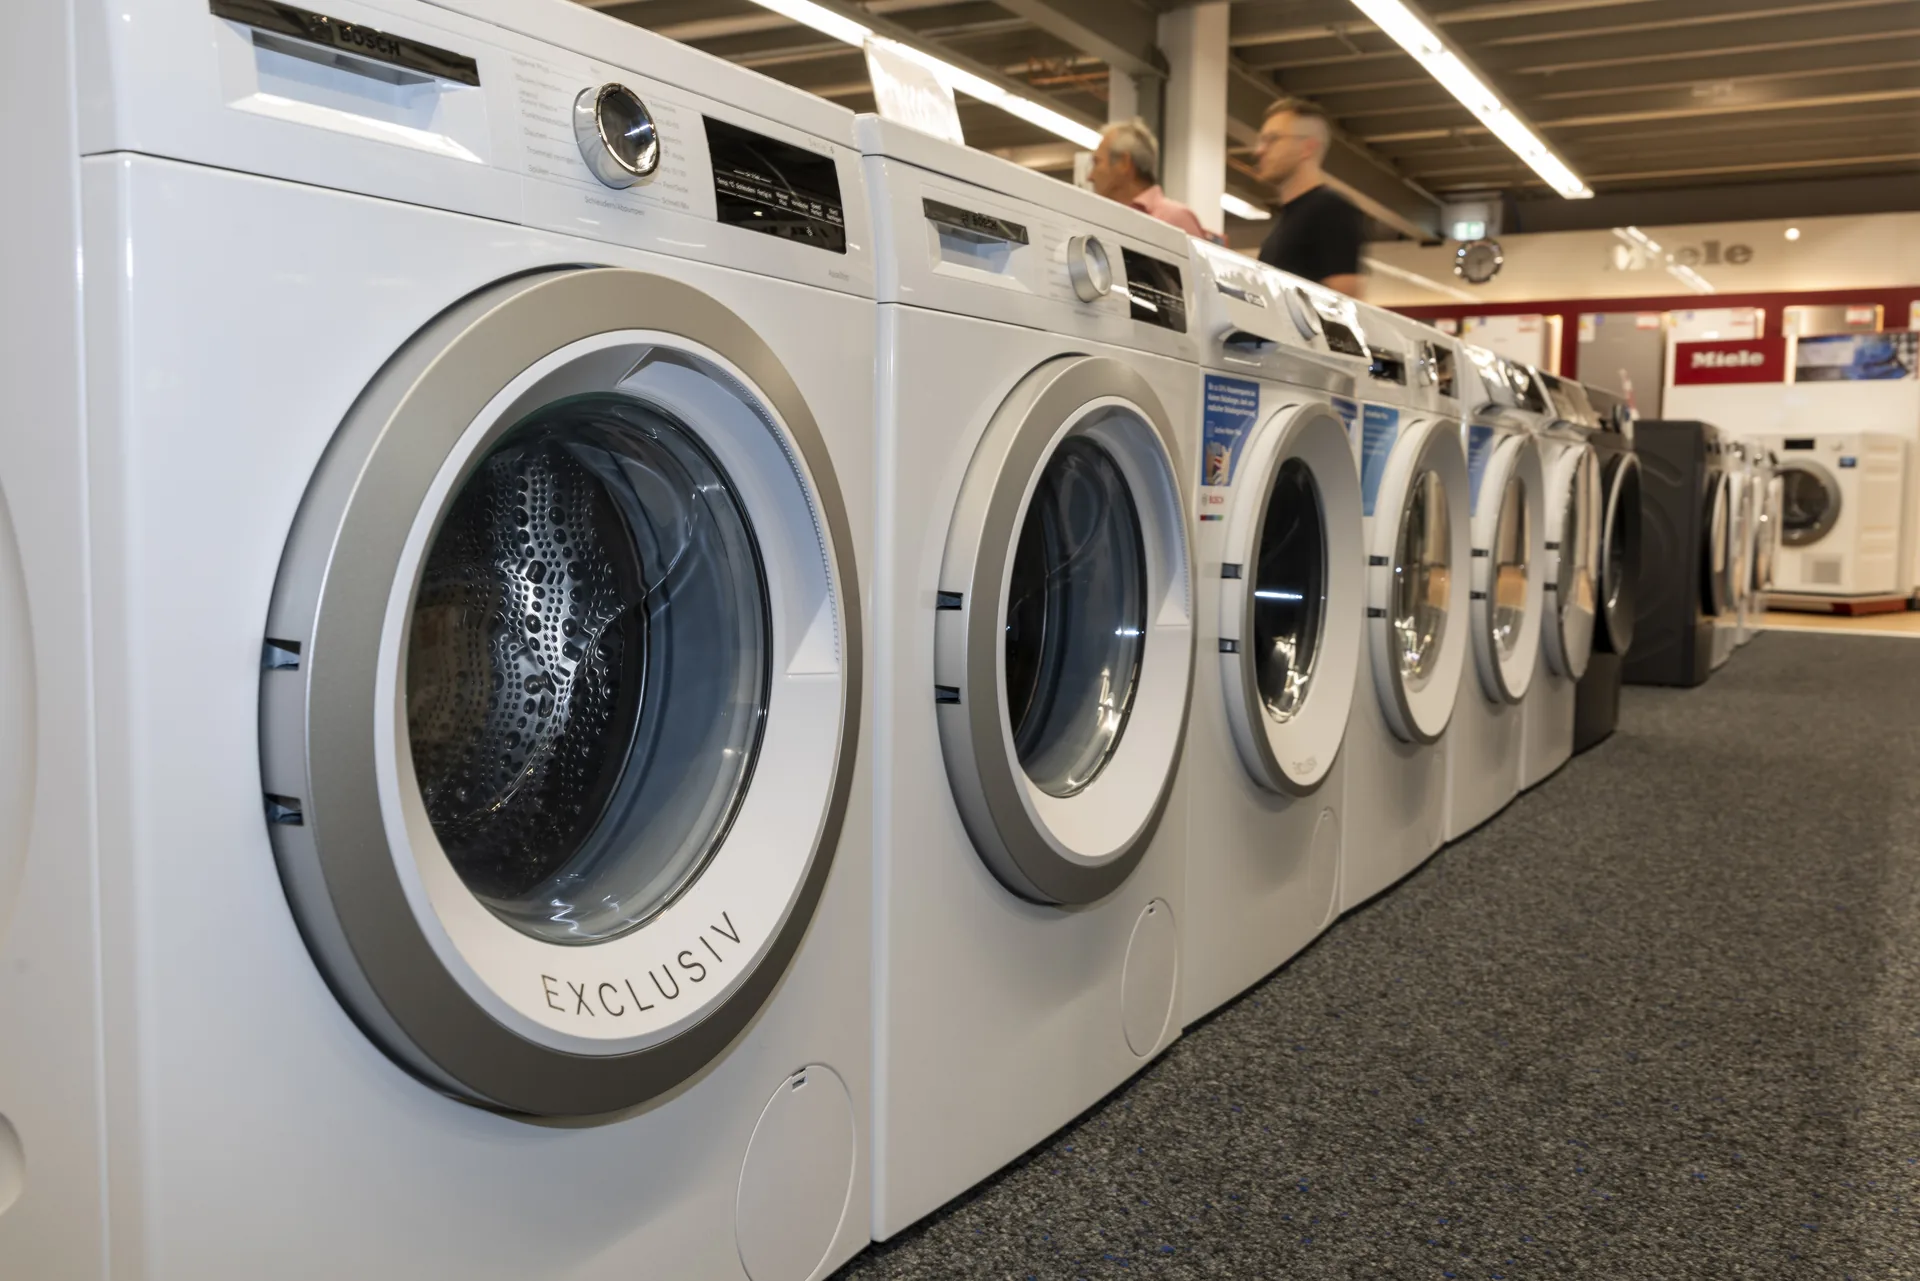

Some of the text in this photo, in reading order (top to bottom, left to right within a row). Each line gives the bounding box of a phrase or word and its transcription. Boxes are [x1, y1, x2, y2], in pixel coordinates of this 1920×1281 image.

[339, 25, 401, 57] BOSCH
[1602, 239, 1754, 272] Mele
[1691, 349, 1765, 369] Miele
[541, 911, 741, 1017] EXCLUSIV
